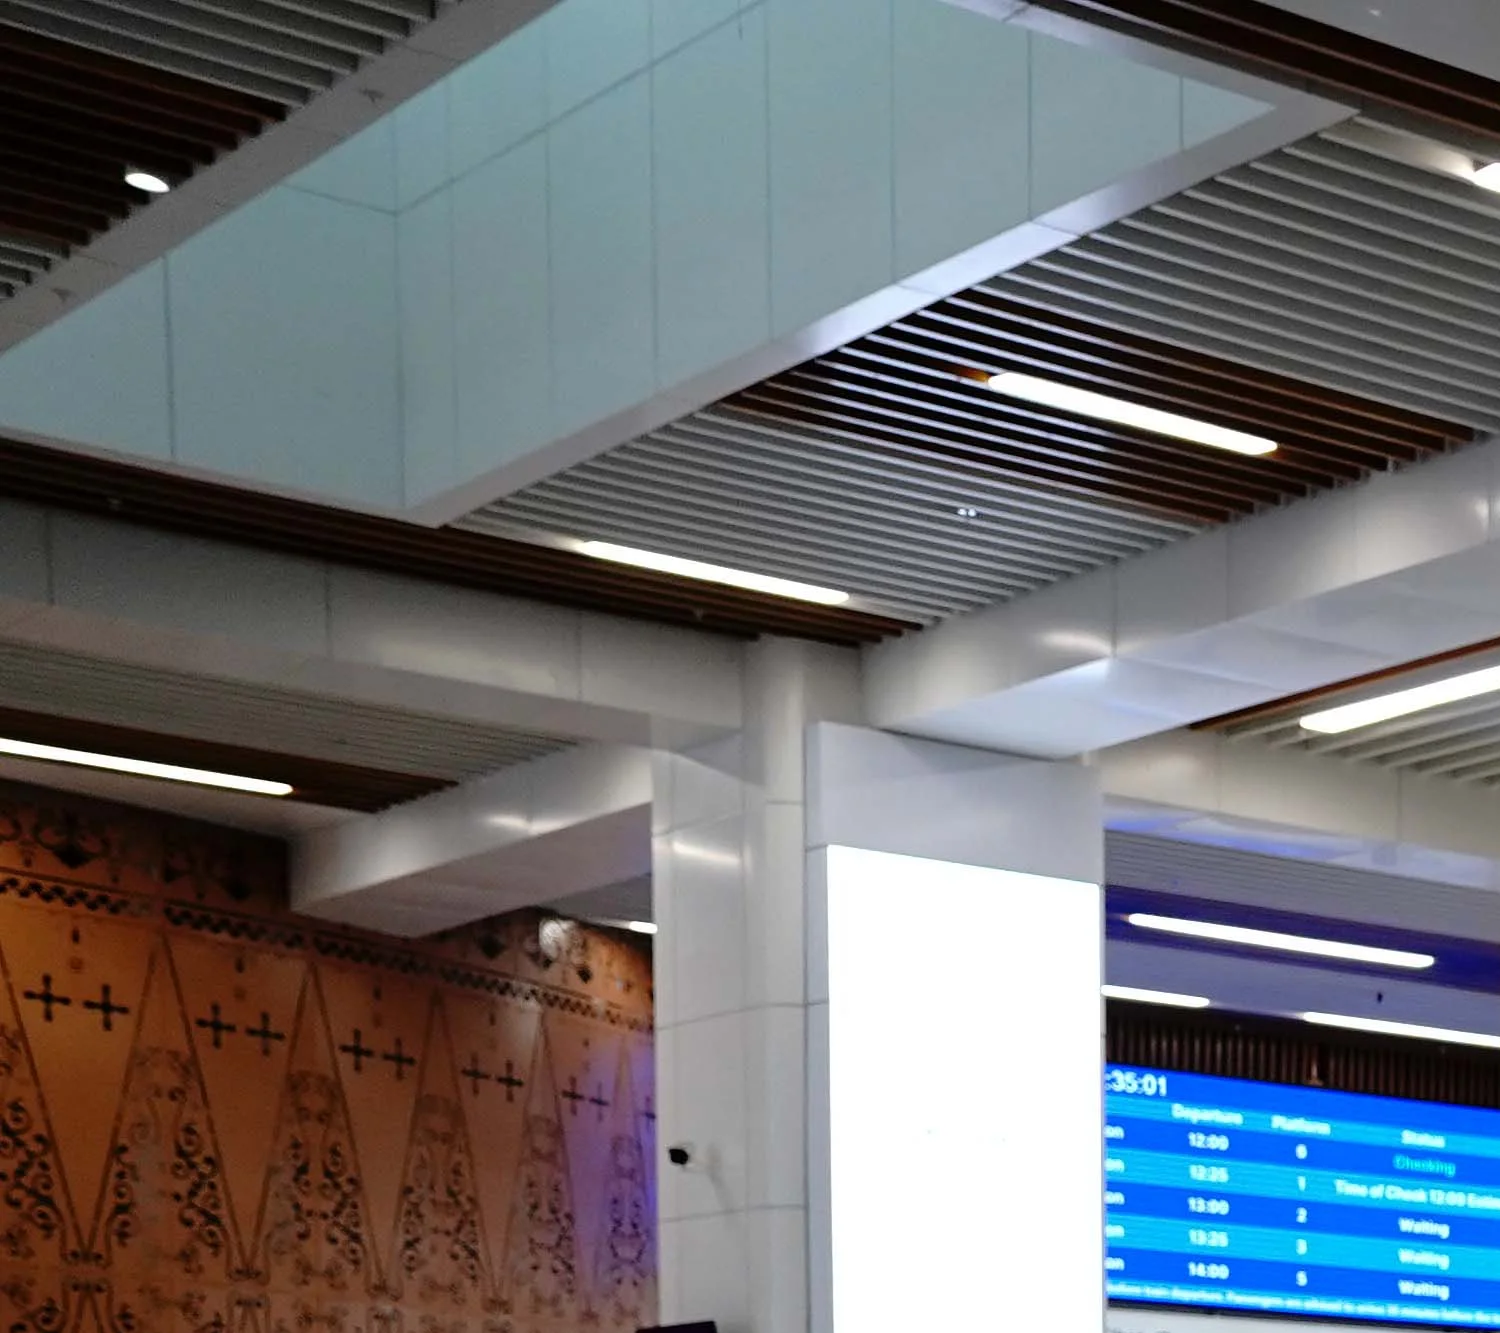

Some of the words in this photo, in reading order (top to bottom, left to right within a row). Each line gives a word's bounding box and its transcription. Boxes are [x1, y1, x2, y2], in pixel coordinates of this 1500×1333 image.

[1398, 1217, 1450, 1240] Waiting
[1398, 1248, 1450, 1271] Waiting
[1398, 1279, 1450, 1301] Waiting
